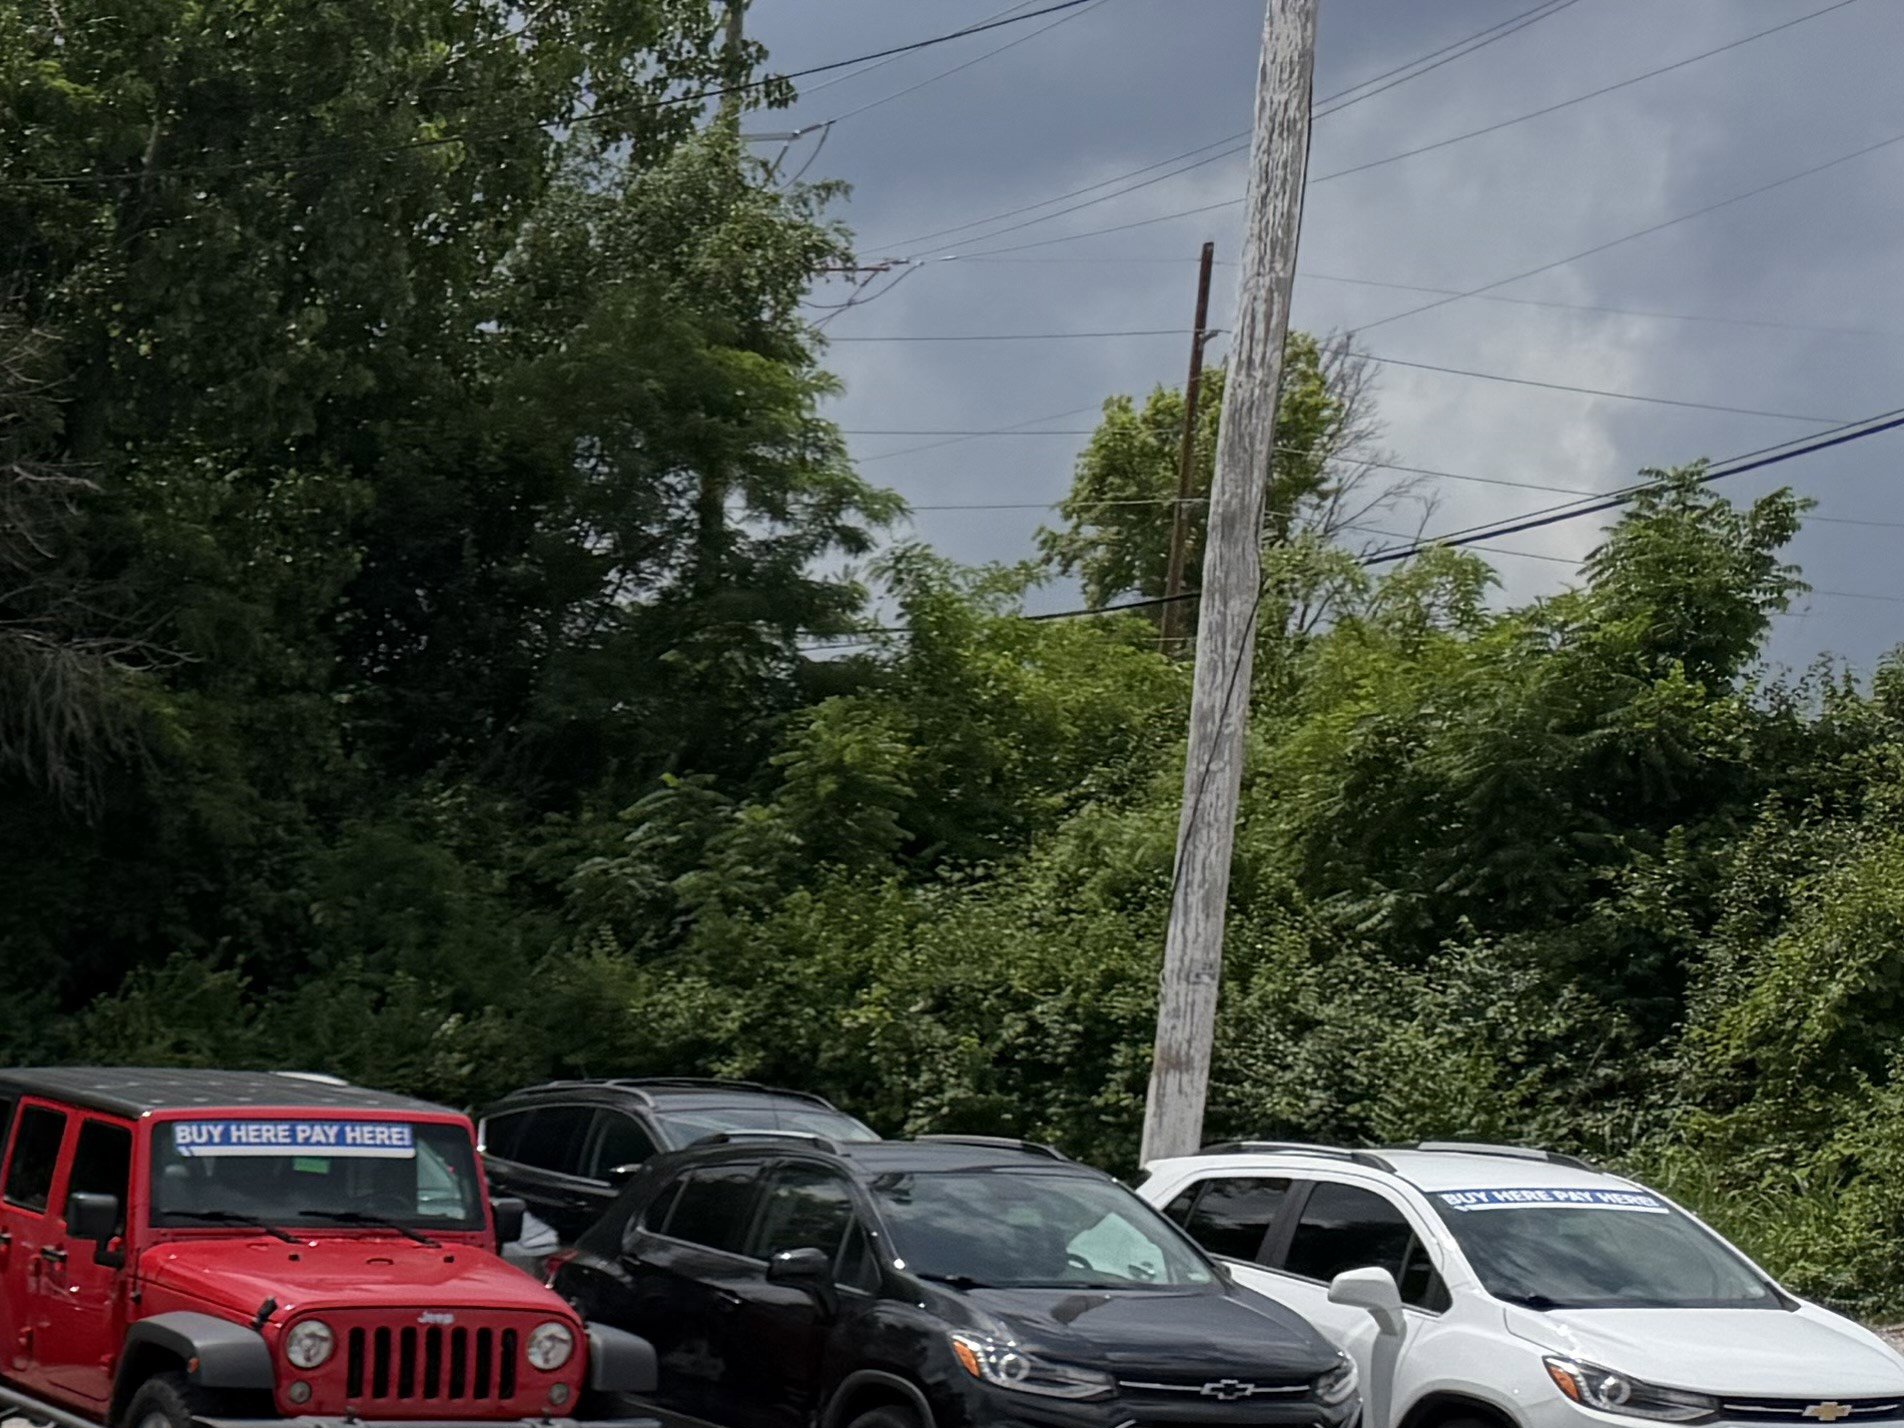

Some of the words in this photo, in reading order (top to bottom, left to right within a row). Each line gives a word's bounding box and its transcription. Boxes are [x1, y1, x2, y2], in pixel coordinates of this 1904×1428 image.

[175, 1125, 224, 1144] BUY
[230, 1125, 291, 1144] HERE
[295, 1125, 339, 1144] PAY
[344, 1126, 412, 1146] HERE!
[1441, 1192, 1490, 1206] BUY
[1492, 1190, 1553, 1204] HERE
[1551, 1190, 1594, 1203] PAY
